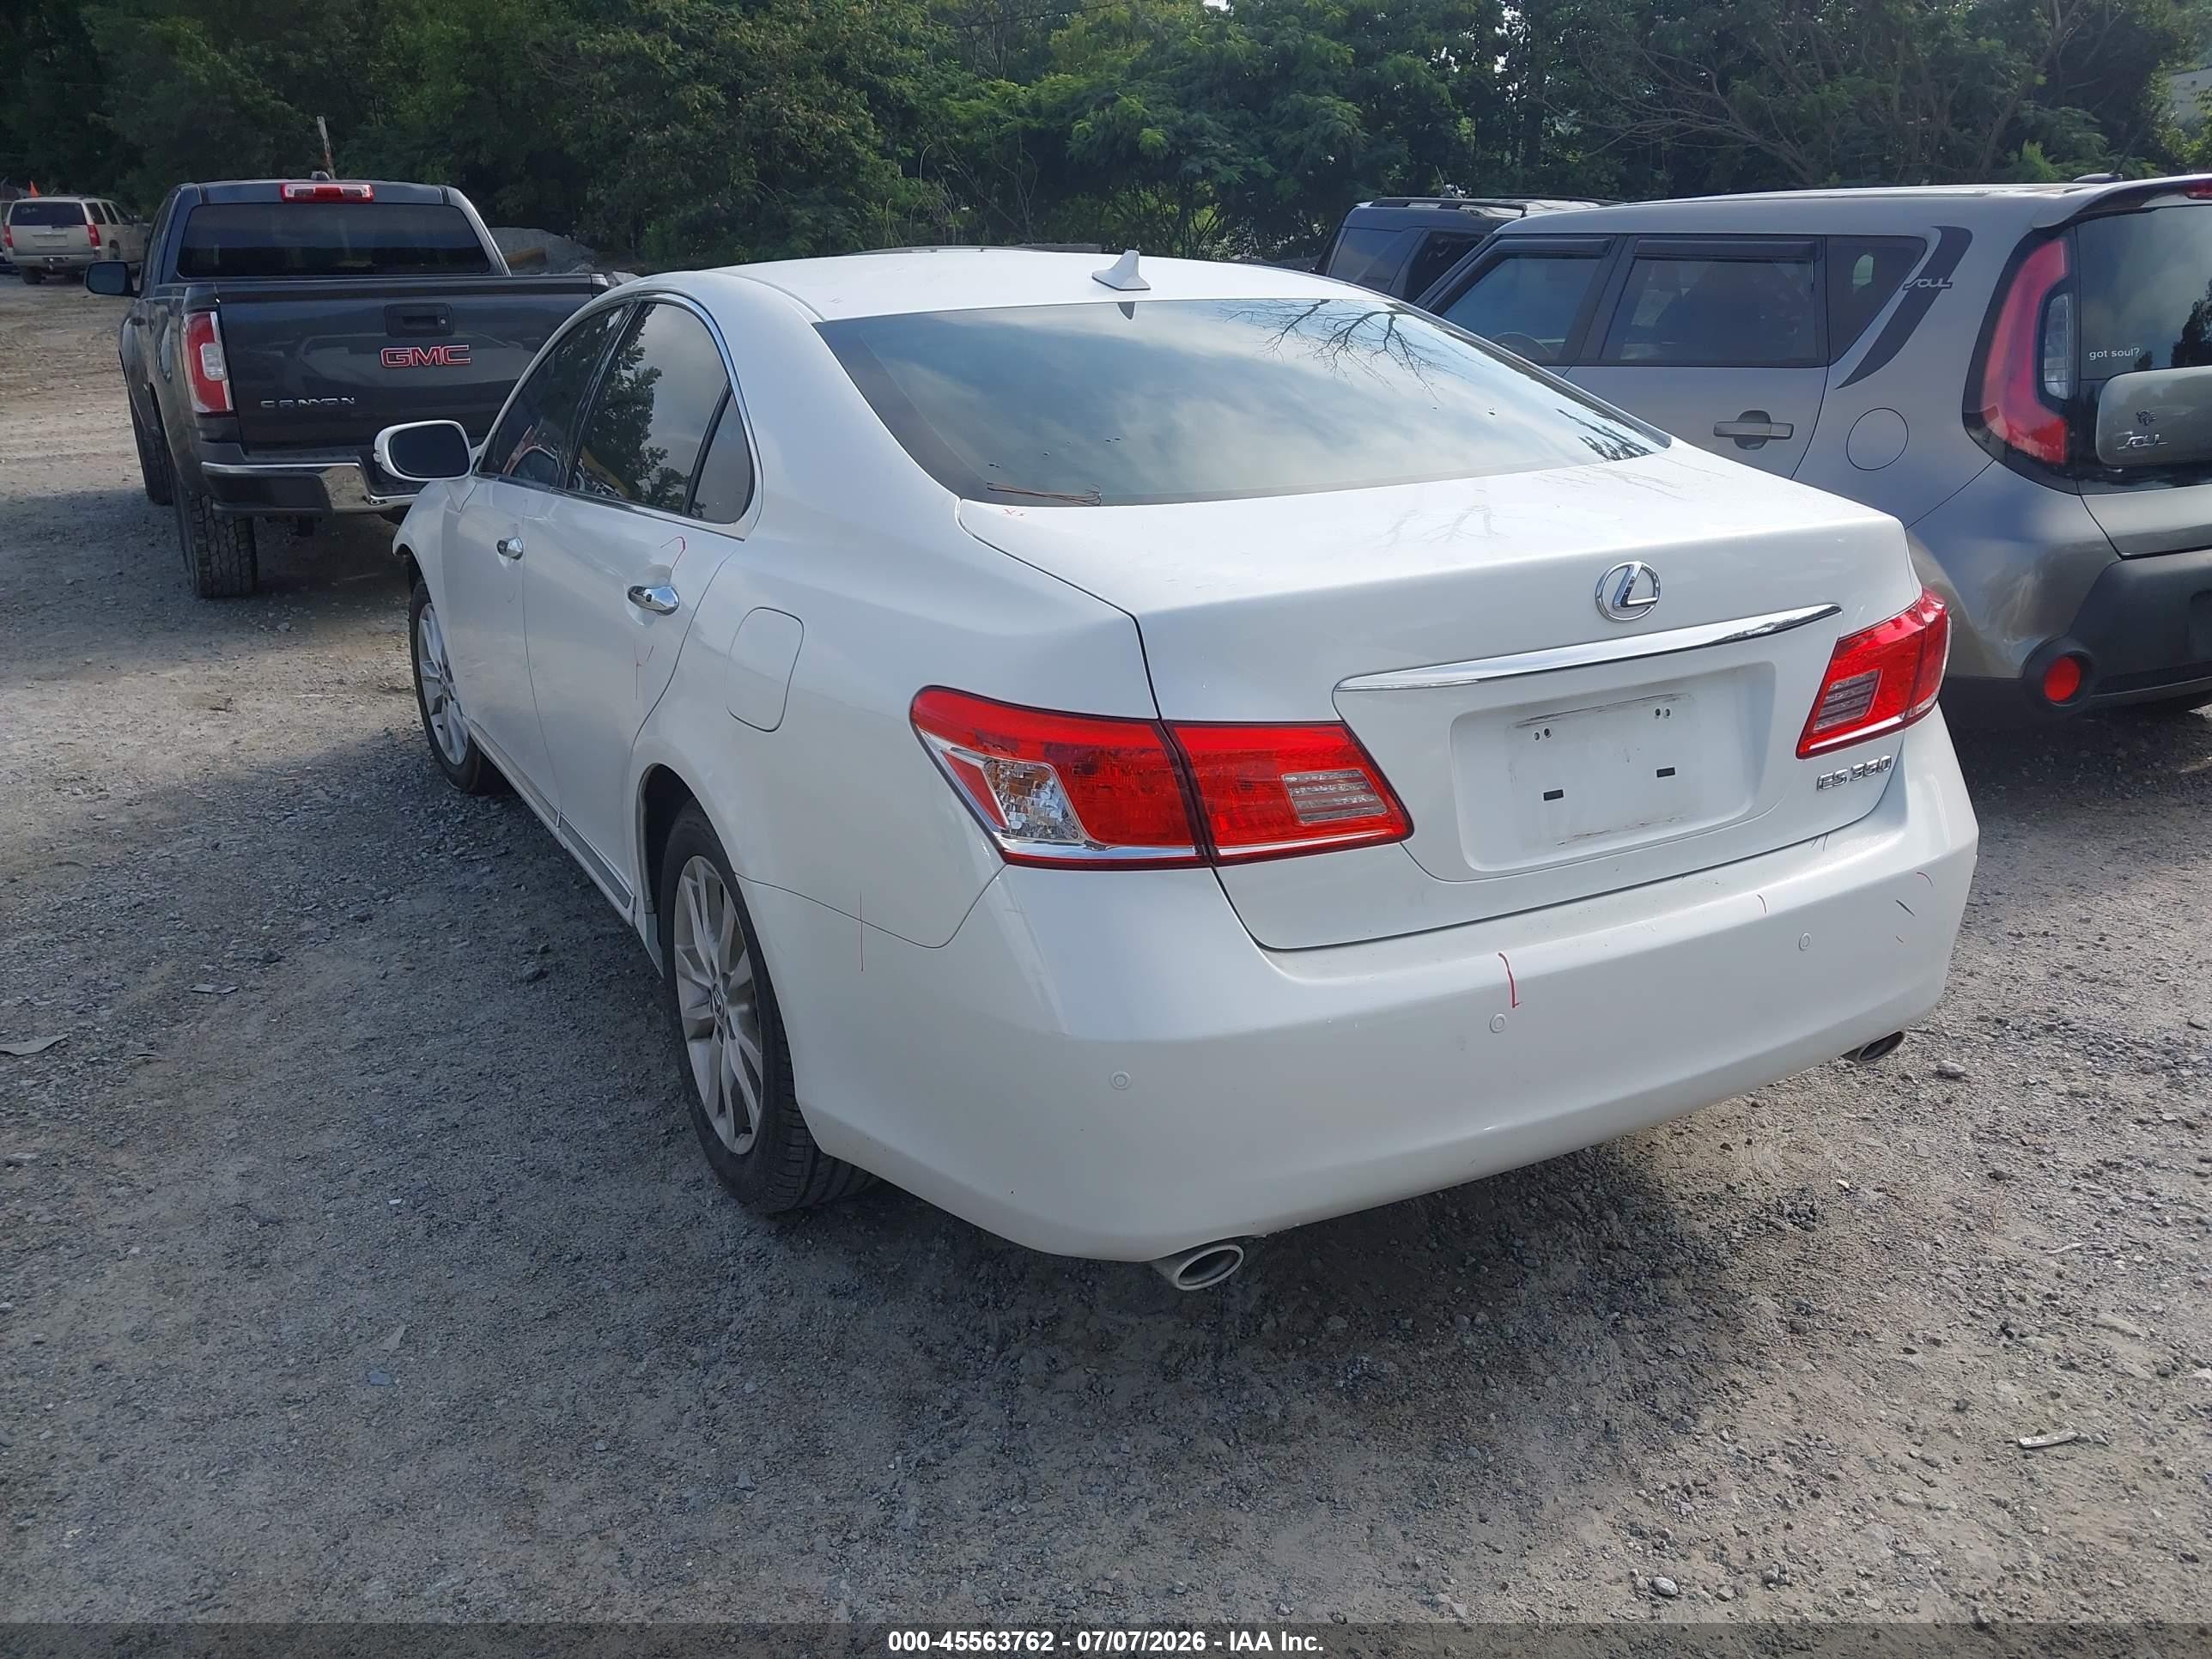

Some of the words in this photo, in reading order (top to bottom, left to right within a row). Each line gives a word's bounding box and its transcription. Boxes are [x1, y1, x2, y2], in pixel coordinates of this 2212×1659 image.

[380, 344, 471, 368] GMC
[2089, 349, 2107, 361] got
[2111, 347, 2140, 358] soul?
[1817, 769, 1848, 791] ES
